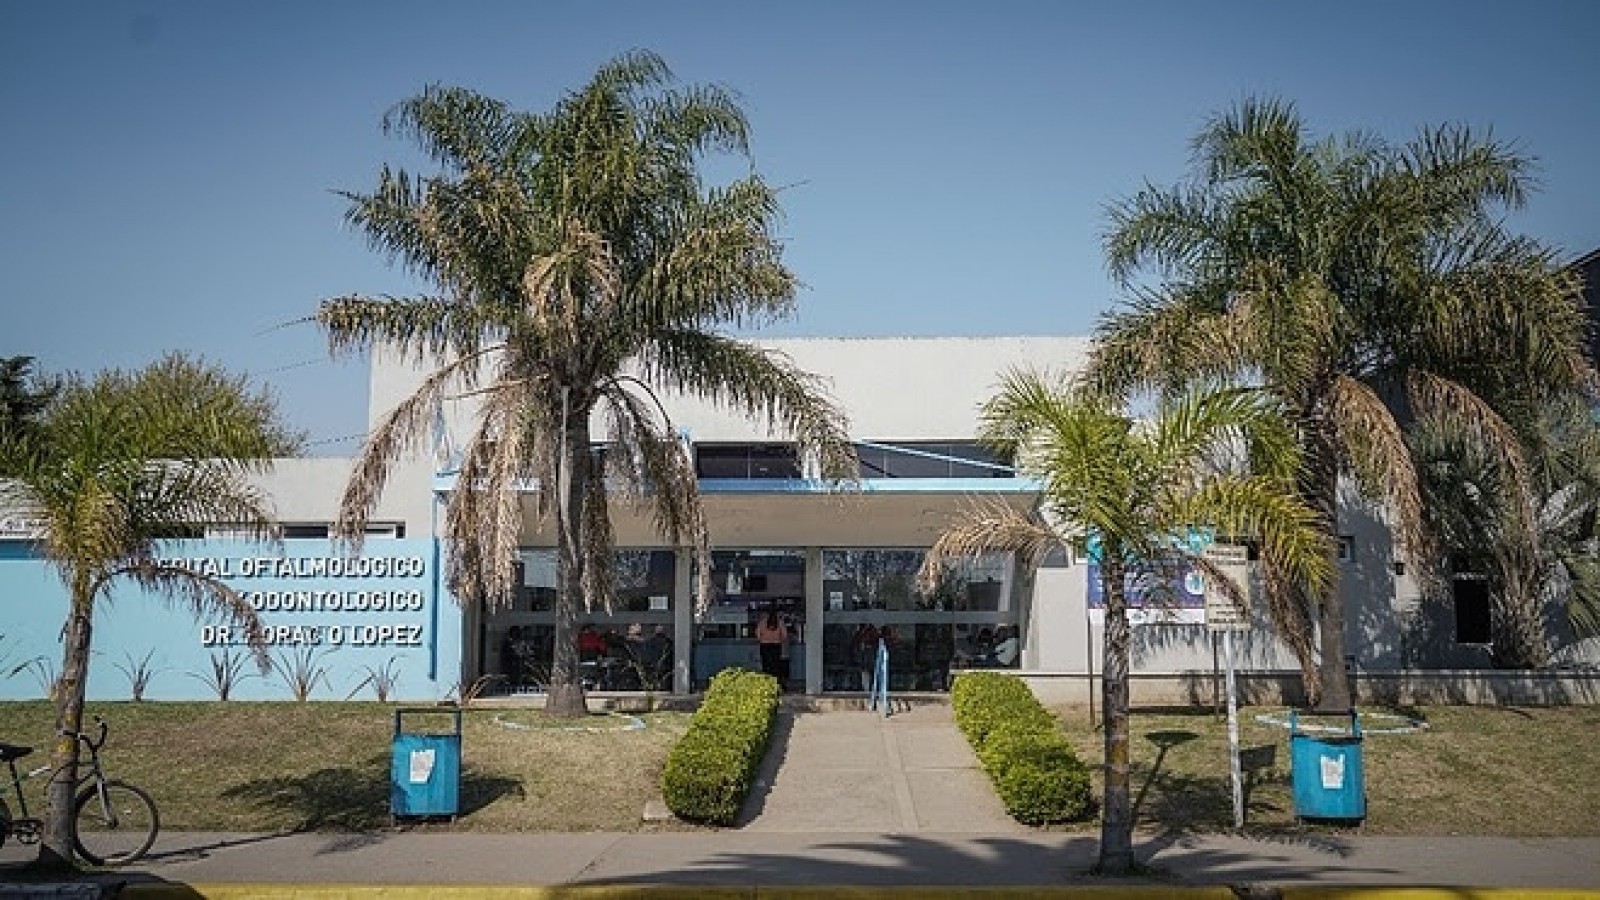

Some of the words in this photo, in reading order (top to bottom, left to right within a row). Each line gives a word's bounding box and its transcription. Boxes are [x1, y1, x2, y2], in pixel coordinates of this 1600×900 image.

[128, 557, 231, 577] SPITAL
[240, 558, 425, 577] OFTALMOLOGICO
[250, 591, 422, 611] ODONTOLOGICO
[248, 625, 341, 646] ORACO
[351, 625, 422, 646] LOPEZ
